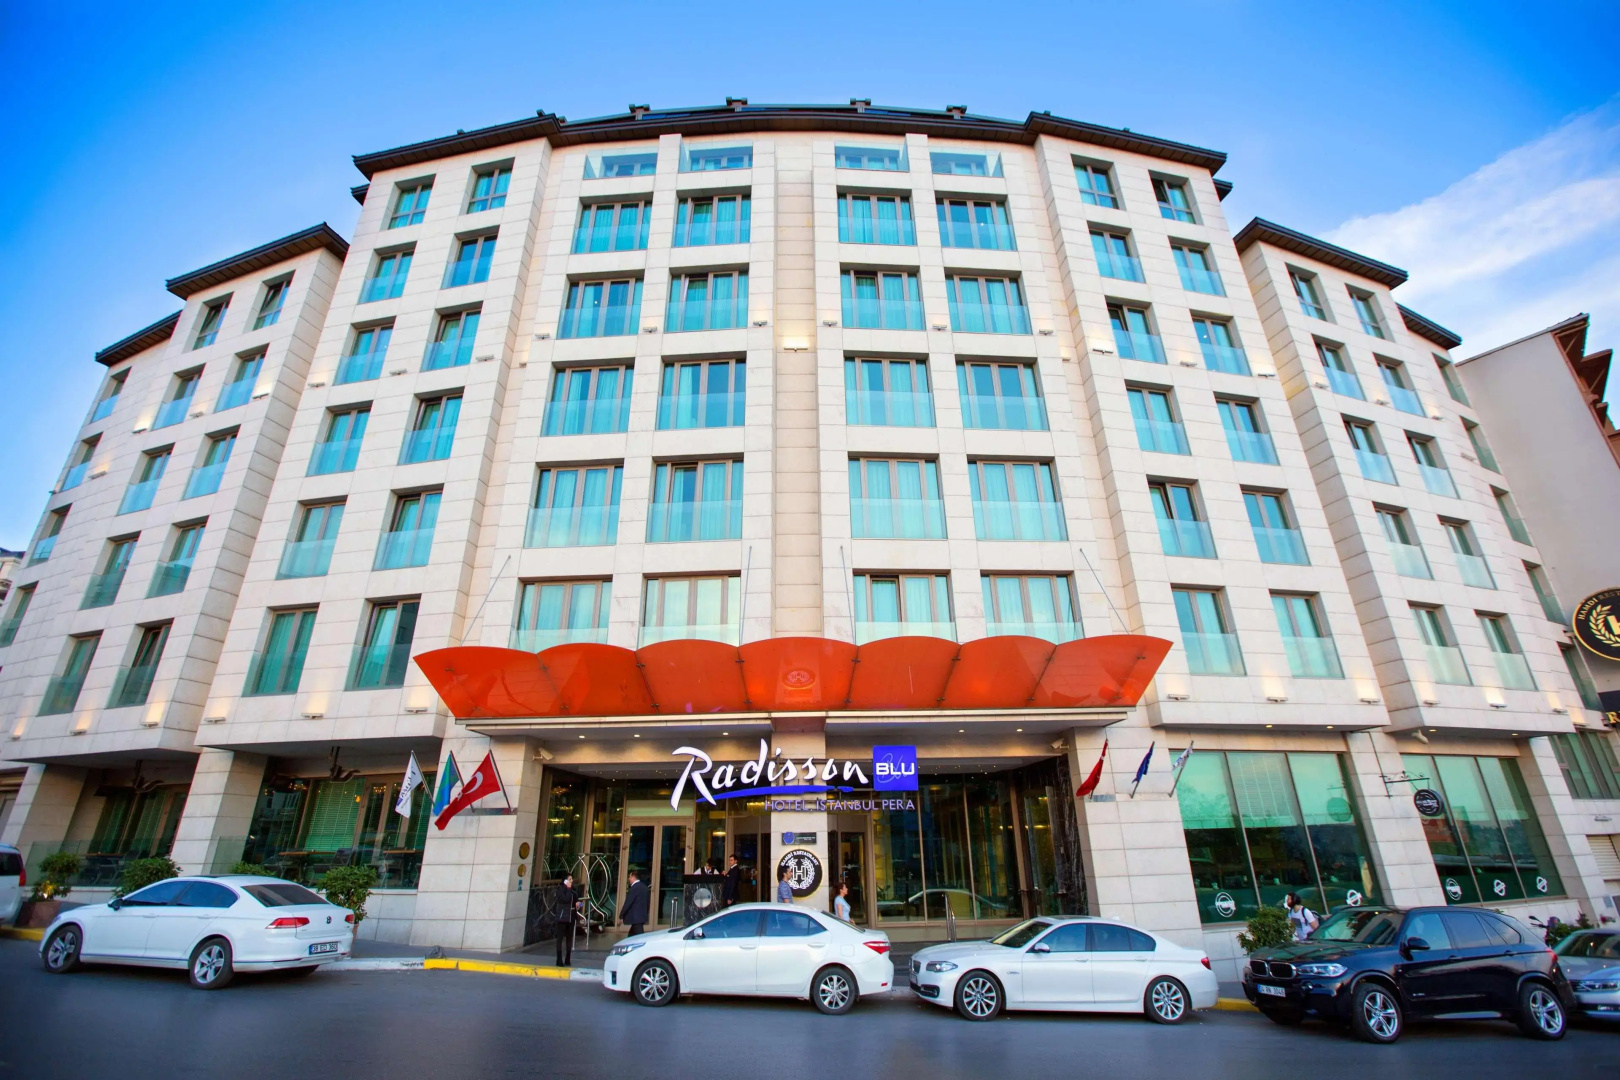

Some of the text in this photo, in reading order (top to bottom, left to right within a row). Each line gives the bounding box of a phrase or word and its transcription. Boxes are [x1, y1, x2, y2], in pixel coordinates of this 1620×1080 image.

[671, 738, 869, 812] Radisson
[876, 762, 915, 775] BLU
[882, 799, 916, 811] PERA
[793, 850, 819, 866] RESTAURANT
[793, 865, 806, 880] H
